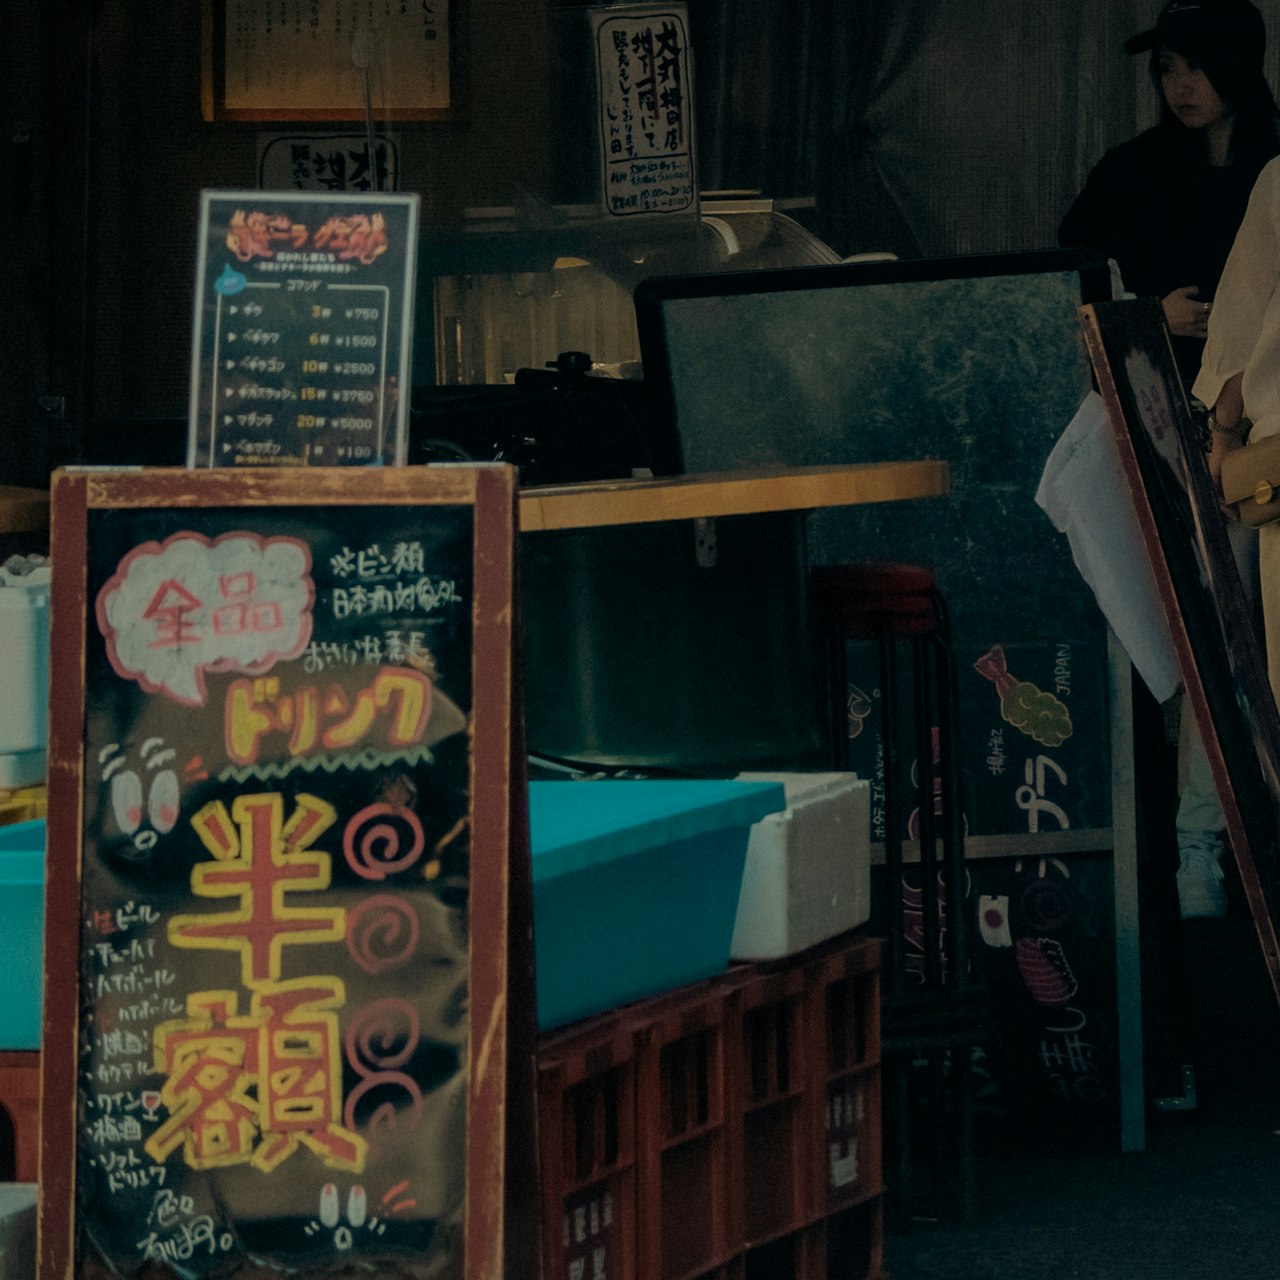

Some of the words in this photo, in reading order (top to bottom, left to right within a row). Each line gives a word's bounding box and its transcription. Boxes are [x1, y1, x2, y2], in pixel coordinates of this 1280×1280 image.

[606, 105, 621, 153] じん田
[143, 573, 284, 648] 全品
[1055, 644, 1073, 697] JAPAN
[224, 666, 432, 766] ドリンク
[144, 793, 369, 1173] 半額
[97, 1092, 141, 1114] ワイン
[98, 1148, 142, 1172] ソフト
